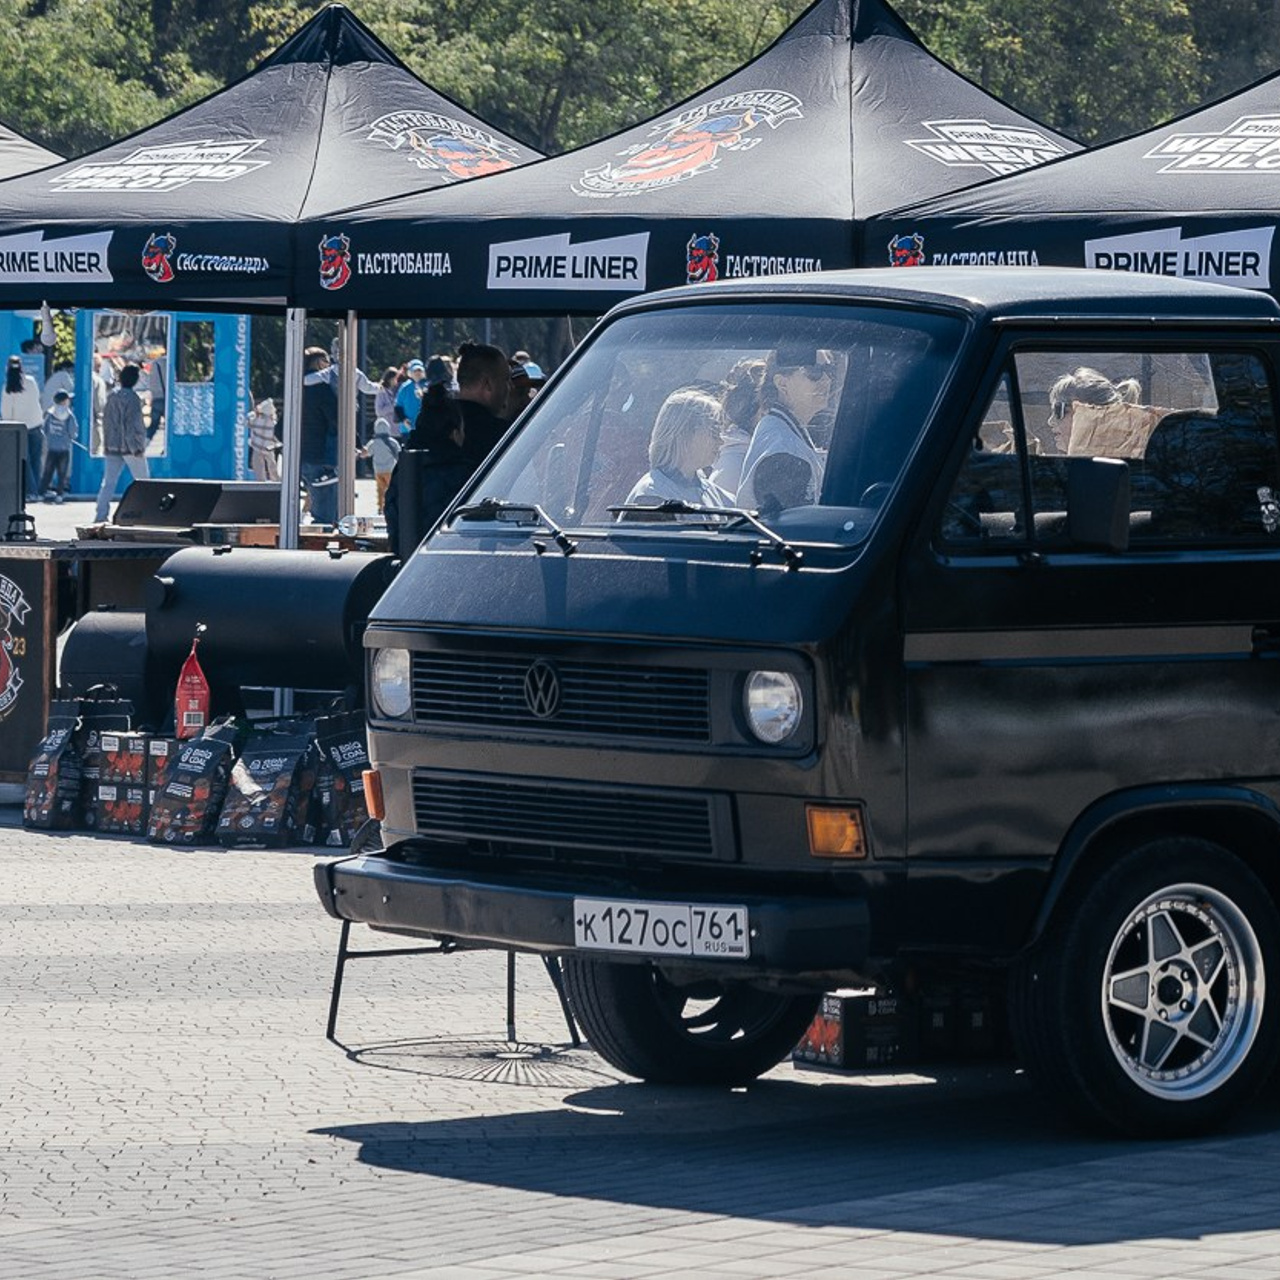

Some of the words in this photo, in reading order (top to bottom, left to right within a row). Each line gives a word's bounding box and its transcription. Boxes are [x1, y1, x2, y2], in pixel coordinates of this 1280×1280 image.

[44, 251, 103, 273] LINER
[357, 252, 452, 277] ГАСТРОБАНДА
[495, 256, 567, 279] PRIME
[571, 256, 638, 280] LINER
[1094, 251, 1178, 276] PRIME
[1183, 251, 1261, 277] LINER
[12, 636, 27, 656] 23
[692, 910, 742, 941] 761
[704, 941, 728, 953] RUS
